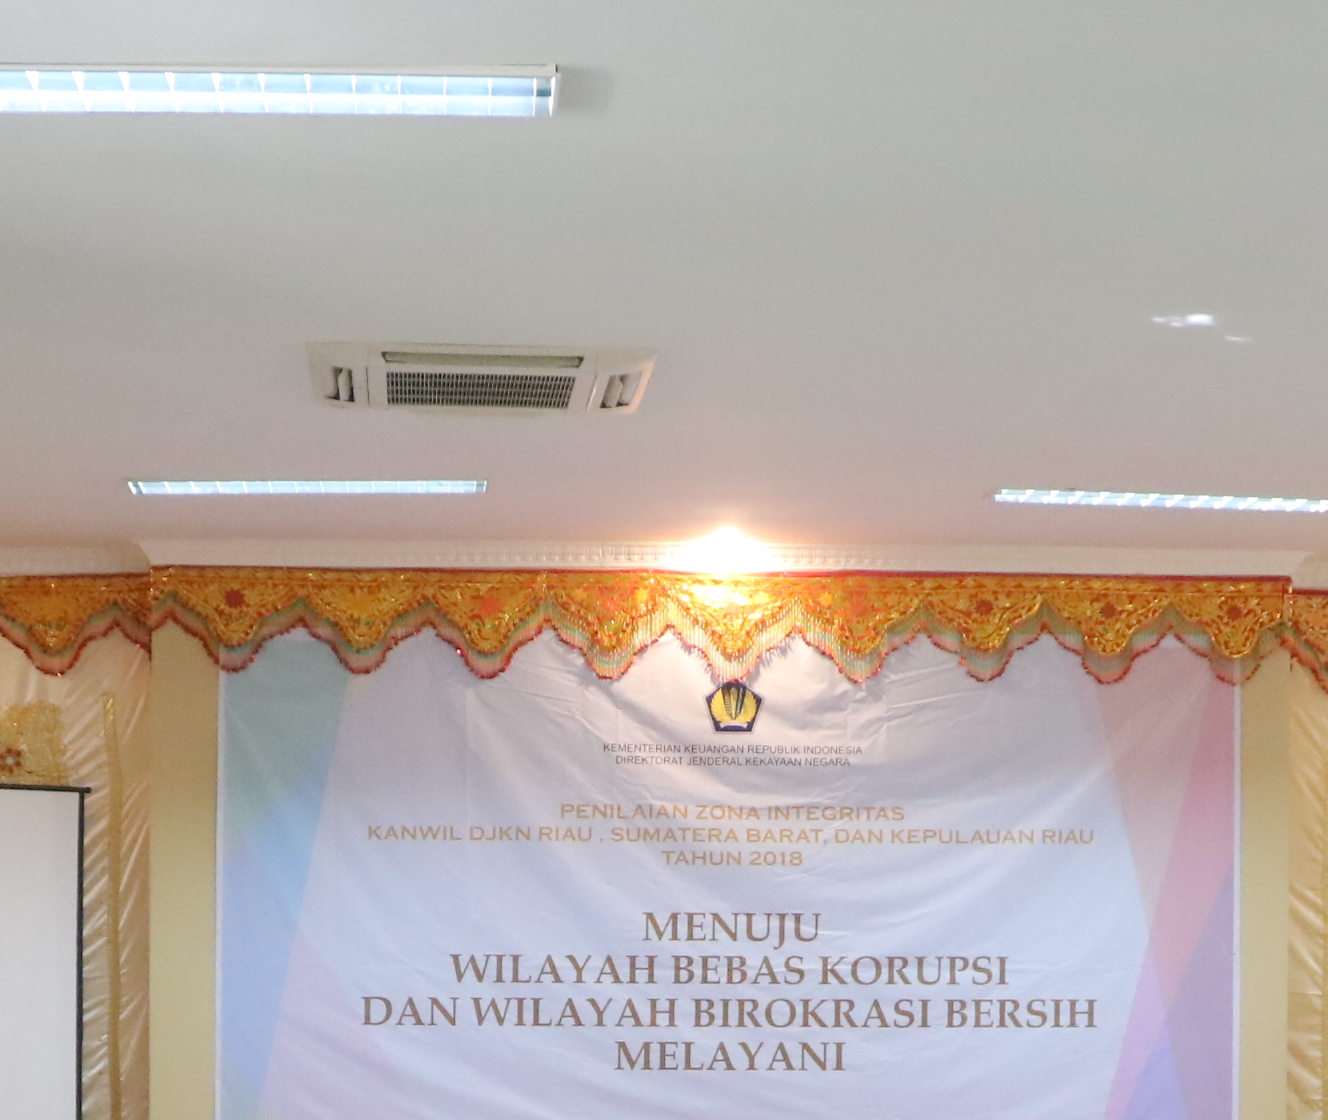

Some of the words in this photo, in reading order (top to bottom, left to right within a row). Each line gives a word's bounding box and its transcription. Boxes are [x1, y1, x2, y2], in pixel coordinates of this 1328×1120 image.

[603, 743, 681, 754] KEMENTERIAN
[684, 744, 744, 755] KEUANGAN
[747, 744, 800, 755] REPUBLIK
[803, 745, 863, 756] INDONESIA
[616, 755, 684, 766] DIREKTORAT
[687, 756, 742, 766] JENDERAL
[746, 756, 802, 767] KEKAYAAN
[805, 757, 851, 768] NEGARA
[561, 803, 689, 820] PENILAIAN
[695, 804, 761, 821] ZONA
[767, 805, 905, 822] INTEGRITAS
[367, 824, 463, 841] KANWIL
[469, 825, 531, 841] DJKN
[538, 826, 593, 842] RIAU
[610, 826, 739, 843] SUMATERA
[746, 828, 828, 846] BARAT,
[834, 828, 884, 844] DAN
[890, 828, 1035, 844] KEPULAUAN
[1041, 829, 1095, 845] RIAU
[661, 850, 744, 866] TAHUN
[748, 851, 804, 867] 2018
[642, 911, 822, 950] MENUJU
[449, 953, 659, 984] WILAYAH
[671, 955, 806, 985] BEBAS
[818, 955, 1010, 986] KORUPSI
[361, 996, 460, 1026] DAN
[470, 996, 679, 1028] WILAYAH
[691, 997, 932, 1028] BIROKRASI
[944, 998, 1099, 1028] BERSIH
[614, 1040, 847, 1072] MELAYANI
